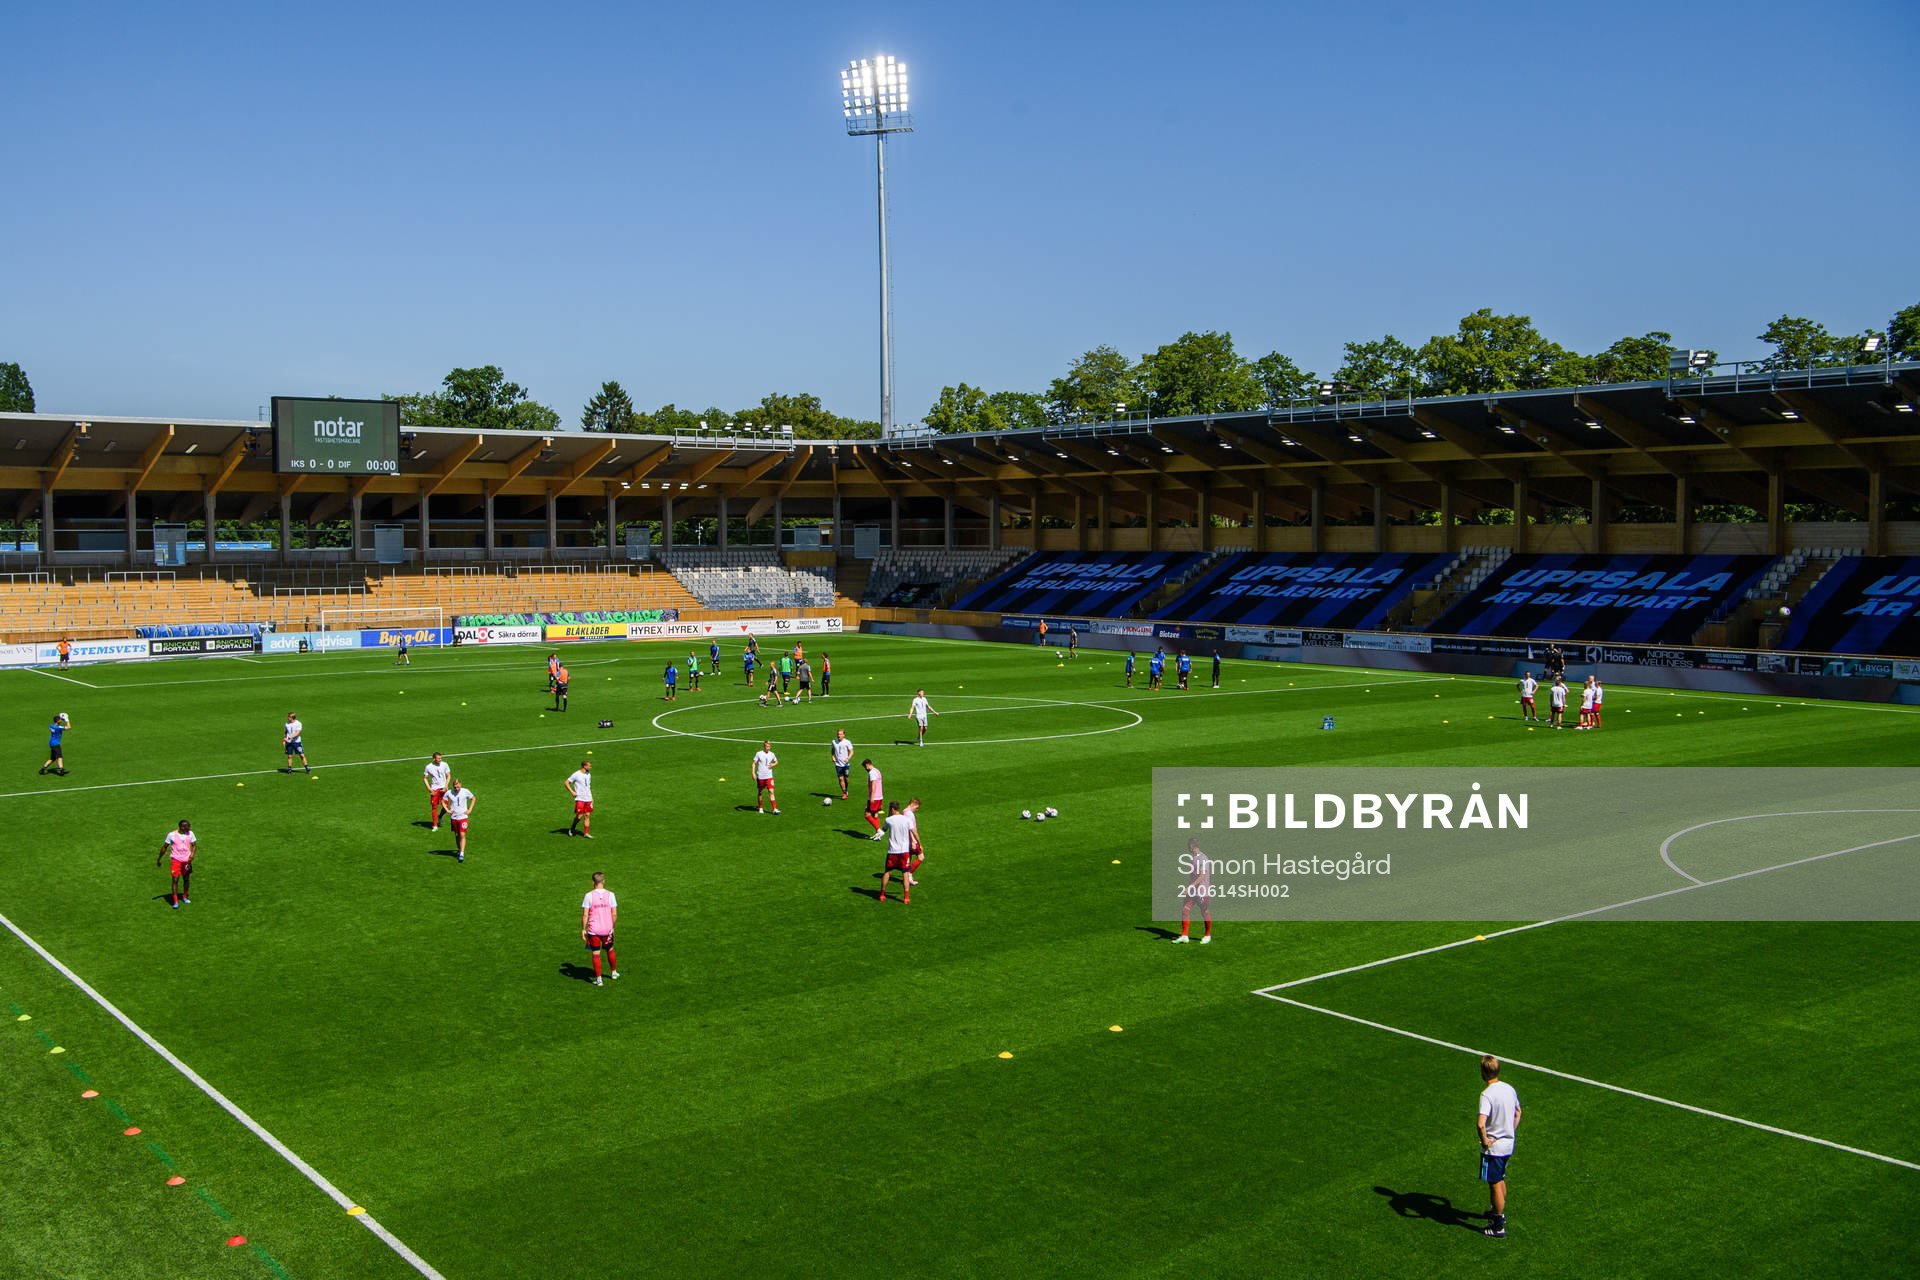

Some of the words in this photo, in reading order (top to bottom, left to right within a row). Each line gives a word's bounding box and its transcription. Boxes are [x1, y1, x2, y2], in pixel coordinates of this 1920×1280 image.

[314, 416, 364, 437] notar
[291, 460, 305, 468] IKS
[309, 459, 317, 469] 0
[327, 459, 334, 469] 0
[338, 460, 351, 469] DIF
[366, 460, 396, 470] 00:00
[1026, 562, 1167, 579] UPPSALA
[1228, 565, 1404, 584] UPPSALA
[1500, 569, 1734, 591] UPPSALA
[1210, 582, 1251, 595] ÄR
[1480, 588, 1533, 604] ÄR
[1528, 591, 1713, 609] BLÅSVART
[1842, 598, 1913, 616] ÄR
[498, 631, 516, 639] Säkra
[631, 626, 662, 635] HYREX
[668, 624, 698, 633] HYREX
[315, 634, 353, 647] advisa
[458, 629, 494, 642] DALOC
[270, 637, 300, 649] advis
[1604, 650, 1634, 663] Home
[1647, 650, 1685, 660] NORDIC
[1638, 657, 1695, 669] WELLNESS
[1865, 664, 1891, 673] BYGG
